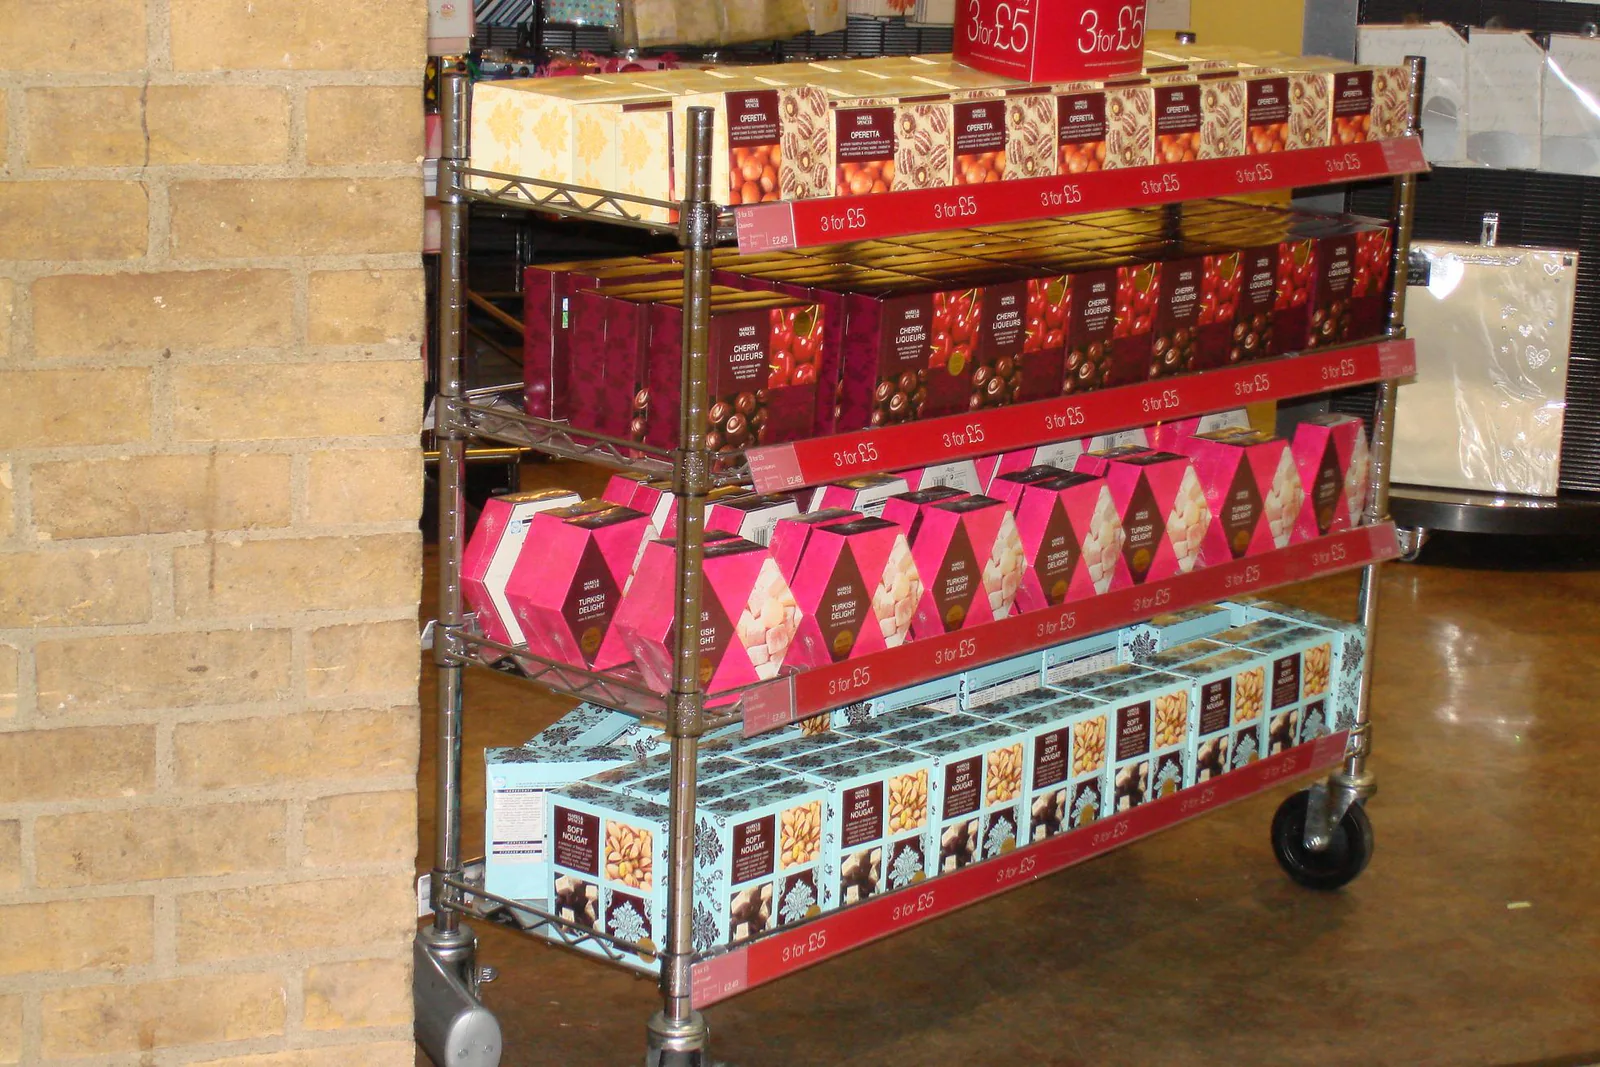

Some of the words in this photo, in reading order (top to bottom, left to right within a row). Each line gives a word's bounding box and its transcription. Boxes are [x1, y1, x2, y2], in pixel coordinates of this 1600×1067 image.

[968, 0, 980, 41] 3
[978, 18, 993, 45] for
[994, 3, 1030, 52] £5
[1078, 10, 1098, 53] 3
[1097, 28, 1116, 52] for
[1116, 5, 1144, 51] £5
[1167, 105, 1189, 114] OPERETTA
[740, 114, 766, 122] OPERETTA
[1069, 114, 1094, 123] OPERETTA
[967, 123, 993, 132] OPERETTA
[851, 131, 880, 139] OPERETTA
[1326, 160, 1332, 172] 3
[1333, 158, 1345, 170] for
[1344, 153, 1361, 170] £5
[1236, 170, 1243, 183] 3
[1244, 168, 1256, 181] for
[1256, 163, 1272, 181] £5
[1141, 181, 1149, 194] 3
[1150, 178, 1162, 193] for
[1163, 173, 1180, 192] £5
[1041, 192, 1048, 206] 3
[1050, 191, 1062, 205] for
[1064, 185, 1081, 203] £5
[934, 204, 942, 218] 3
[944, 203, 956, 217] for
[958, 196, 977, 216] £5
[820, 216, 828, 231] 3
[831, 214, 844, 230] for
[847, 208, 866, 228] £5
[772, 235, 788, 245] £2.49
[1331, 260, 1348, 269] CHERRY
[1253, 272, 1271, 280] CHERRY
[1328, 267, 1351, 277] LIQUEURS
[1250, 279, 1273, 289] LIQUEURS
[1175, 286, 1194, 295] CHERRY
[1088, 298, 1109, 308] CHERRY
[1171, 293, 1196, 303] LIQUEURS
[996, 311, 1018, 321] CHERRY
[1084, 306, 1111, 316] LIQUEURS
[900, 325, 923, 335] CHERRY
[992, 319, 1021, 330] LIQUEURS
[895, 333, 926, 344] LIQUEURS
[734, 343, 760, 353] CHERRY
[730, 352, 763, 362] LIQUEURS
[1321, 367, 1329, 380] 3
[1329, 365, 1339, 378] for
[1339, 359, 1355, 376] £5
[1234, 383, 1242, 395] 3
[1242, 381, 1254, 394] for
[1254, 374, 1270, 392] £5
[1142, 399, 1150, 412] 3
[1150, 396, 1162, 411] for
[1162, 390, 1180, 409] £5
[1044, 415, 1053, 430] 3
[1054, 413, 1066, 427] for
[1066, 406, 1085, 426] £5
[942, 434, 951, 448] 3
[952, 433, 965, 446] for
[966, 424, 985, 444] £5
[833, 453, 841, 467] 3
[843, 451, 856, 465] for
[857, 442, 877, 462] £5
[1131, 524, 1152, 535] TURKISH
[1130, 532, 1152, 542] DELIGHT
[1047, 550, 1069, 562] TURKISH
[1312, 553, 1318, 566] 3
[1319, 551, 1330, 564] for
[1331, 544, 1346, 561] £5
[1047, 558, 1069, 570] DELIGHT
[946, 575, 968, 586] TURKISH
[1225, 575, 1231, 588] 3
[1232, 574, 1244, 586] for
[1245, 564, 1261, 583] £5
[946, 583, 968, 595] DELIGHT
[579, 594, 605, 606] TURKISH
[1132, 598, 1141, 612] 3
[1142, 596, 1153, 609] for
[1154, 588, 1171, 606] £5
[578, 602, 605, 615] DELIGHT
[832, 601, 856, 612] TURKISH
[831, 609, 855, 620] DELIGHT
[1036, 623, 1044, 638] 3
[1046, 621, 1058, 634] for
[1059, 612, 1076, 632] £5
[935, 650, 942, 665] 3
[944, 647, 958, 661] for
[959, 638, 976, 659] £5
[829, 681, 835, 694] 3
[838, 678, 851, 692] for
[853, 666, 870, 688] £5
[1127, 718, 1139, 727] SOFT
[1123, 724, 1143, 735] NOUGAT
[1044, 746, 1058, 754] SOFT
[1041, 751, 1061, 763] NOUGAT
[956, 775, 969, 783] SOFT
[952, 781, 973, 792] NOUGAT
[854, 801, 869, 810] SOFT
[850, 807, 874, 819] NOUGAT
[567, 825, 584, 835] SOFT
[1092, 834, 1100, 846] 3
[1100, 829, 1112, 844] for
[1111, 820, 1129, 839] £5
[562, 832, 588, 845] NOUGAT
[745, 834, 761, 846] SOFT
[741, 841, 765, 855] NOUGAT
[997, 869, 1005, 882] 3
[1004, 866, 1018, 879] for
[1019, 856, 1037, 874] £5
[892, 908, 901, 921] 3
[902, 903, 916, 917] for
[917, 891, 935, 912] £5
[782, 948, 790, 963] 3
[792, 944, 807, 959] for
[808, 930, 826, 953] £5
